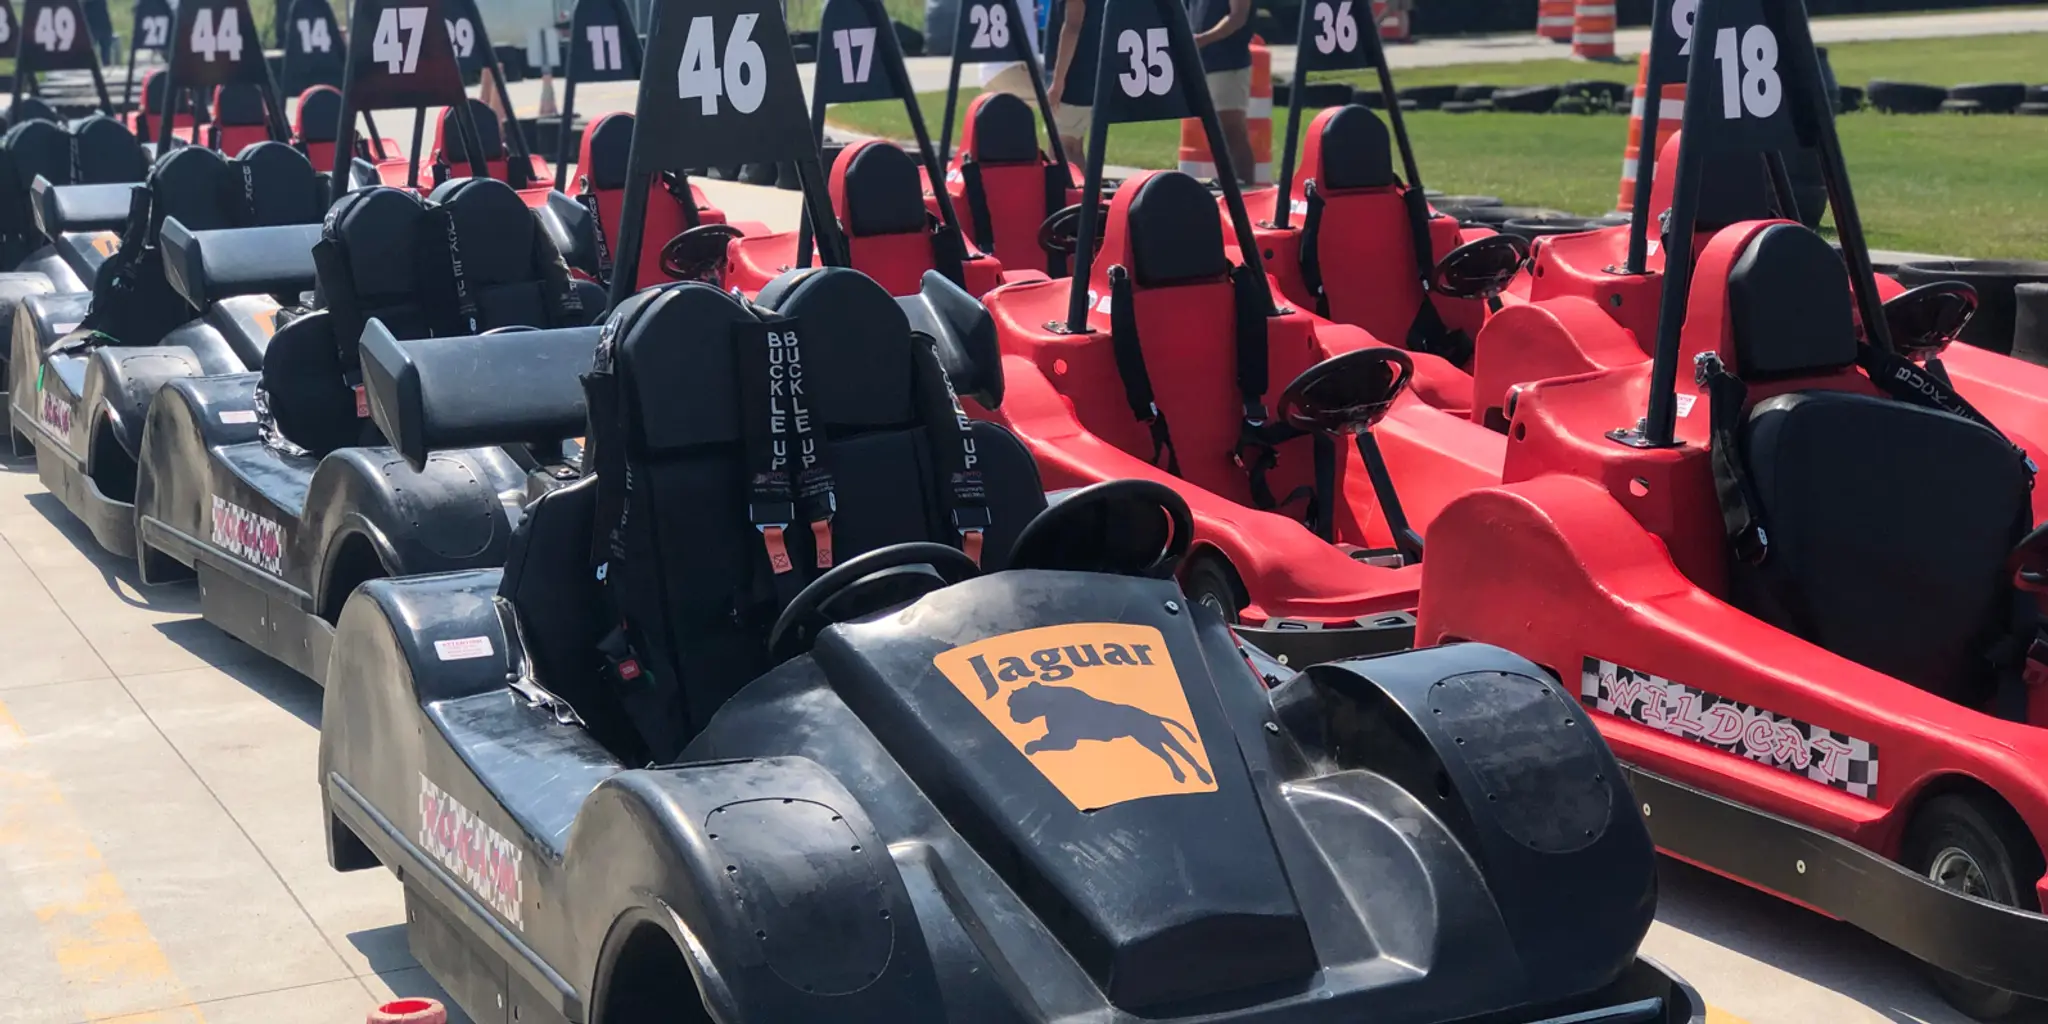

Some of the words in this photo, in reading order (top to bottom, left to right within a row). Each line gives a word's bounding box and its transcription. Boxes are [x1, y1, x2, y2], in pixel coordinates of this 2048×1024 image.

[34, 6, 76, 51] 49
[141, 16, 169, 46] 27
[190, 8, 242, 62] 44
[298, 18, 331, 53] 14
[372, 6, 429, 75] 47
[586, 25, 622, 70] 11
[970, 4, 1009, 48] 28
[1314, 1, 1357, 54] 36
[678, 13, 767, 116] 46
[833, 27, 877, 84] 17
[1117, 28, 1174, 98] 35
[1713, 24, 1783, 119] 18
[767, 331, 786, 433] BUCKLE
[783, 331, 812, 433] BUCKLE
[802, 438, 816, 469] UP
[771, 440, 787, 471] UP
[963, 438, 978, 469] UP
[967, 642, 1155, 700] Jaguar
[1602, 672, 1853, 779] WILDCAT
